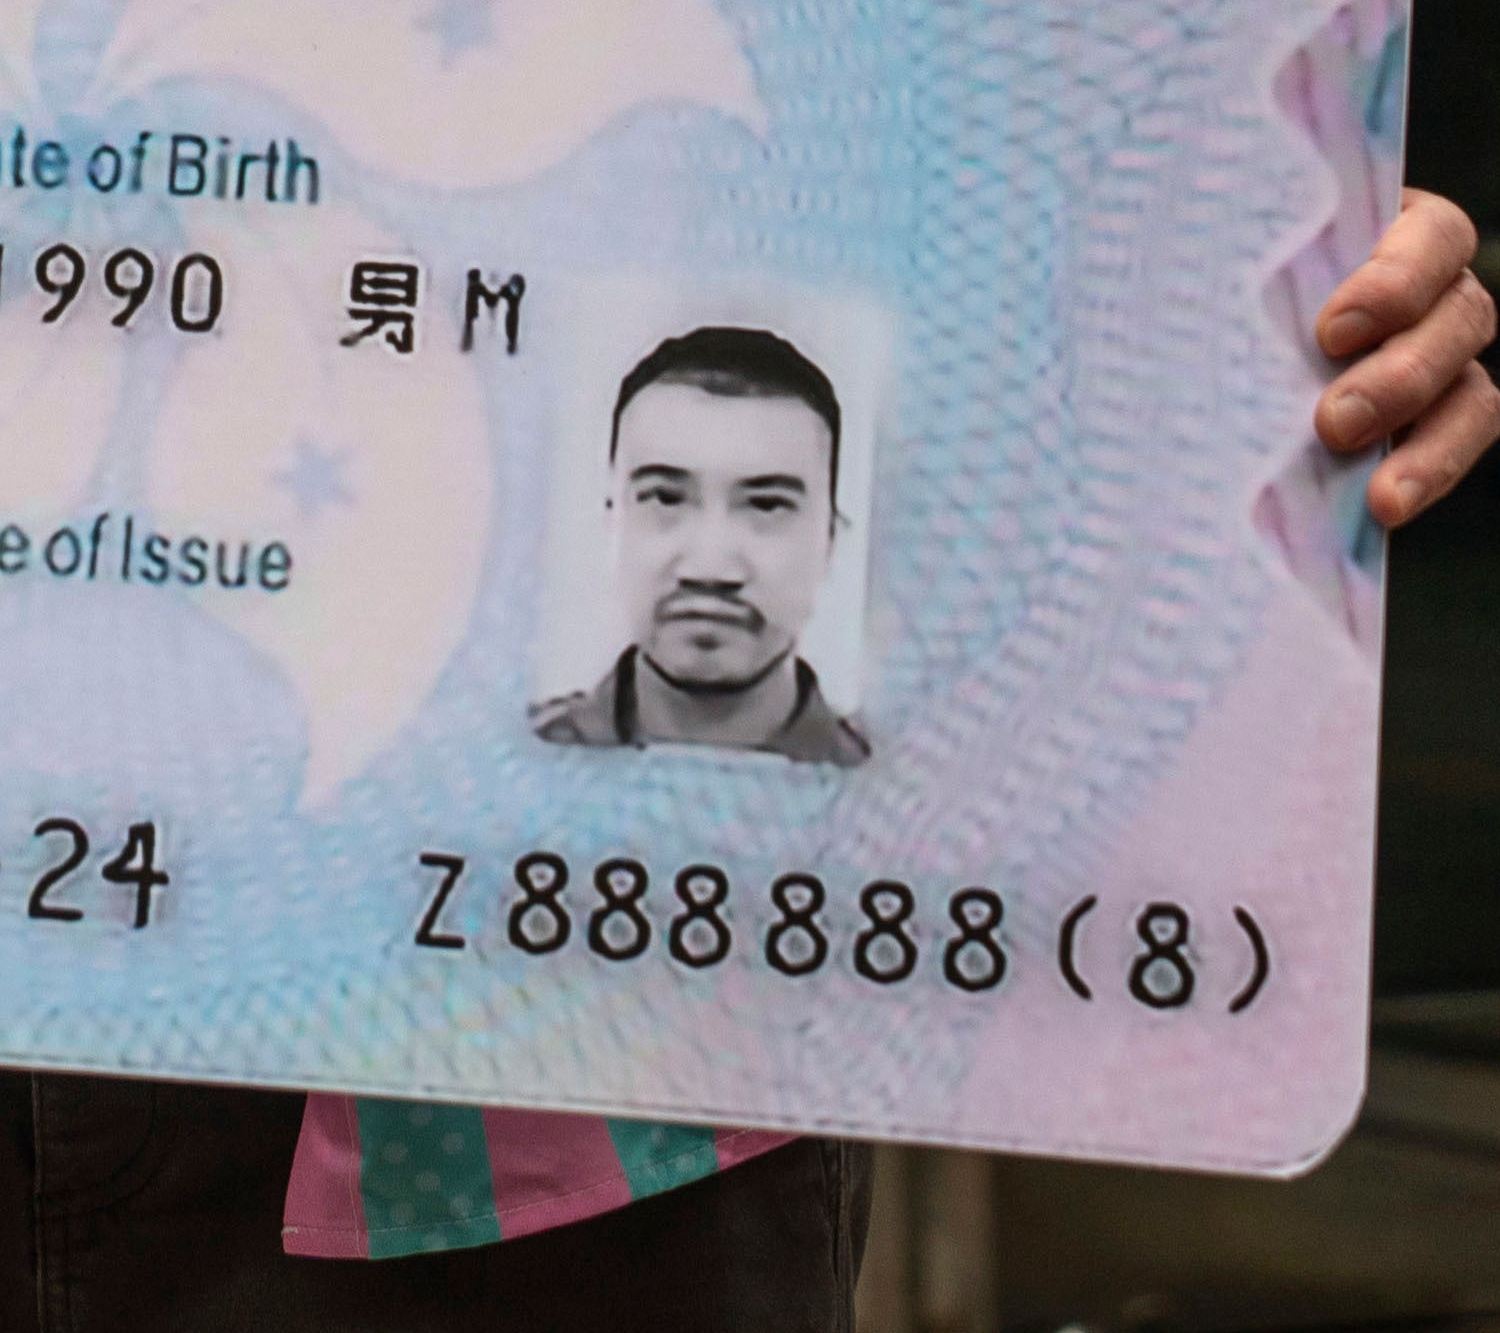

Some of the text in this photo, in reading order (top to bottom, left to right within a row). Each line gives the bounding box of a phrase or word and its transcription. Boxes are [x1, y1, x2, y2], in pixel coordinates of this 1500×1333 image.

[86, 130, 152, 194] of
[165, 134, 322, 205] Birth
[339, 260, 419, 355] 男
[459, 265, 526, 355] M
[45, 511, 111, 582] of
[120, 516, 295, 592] Issue
